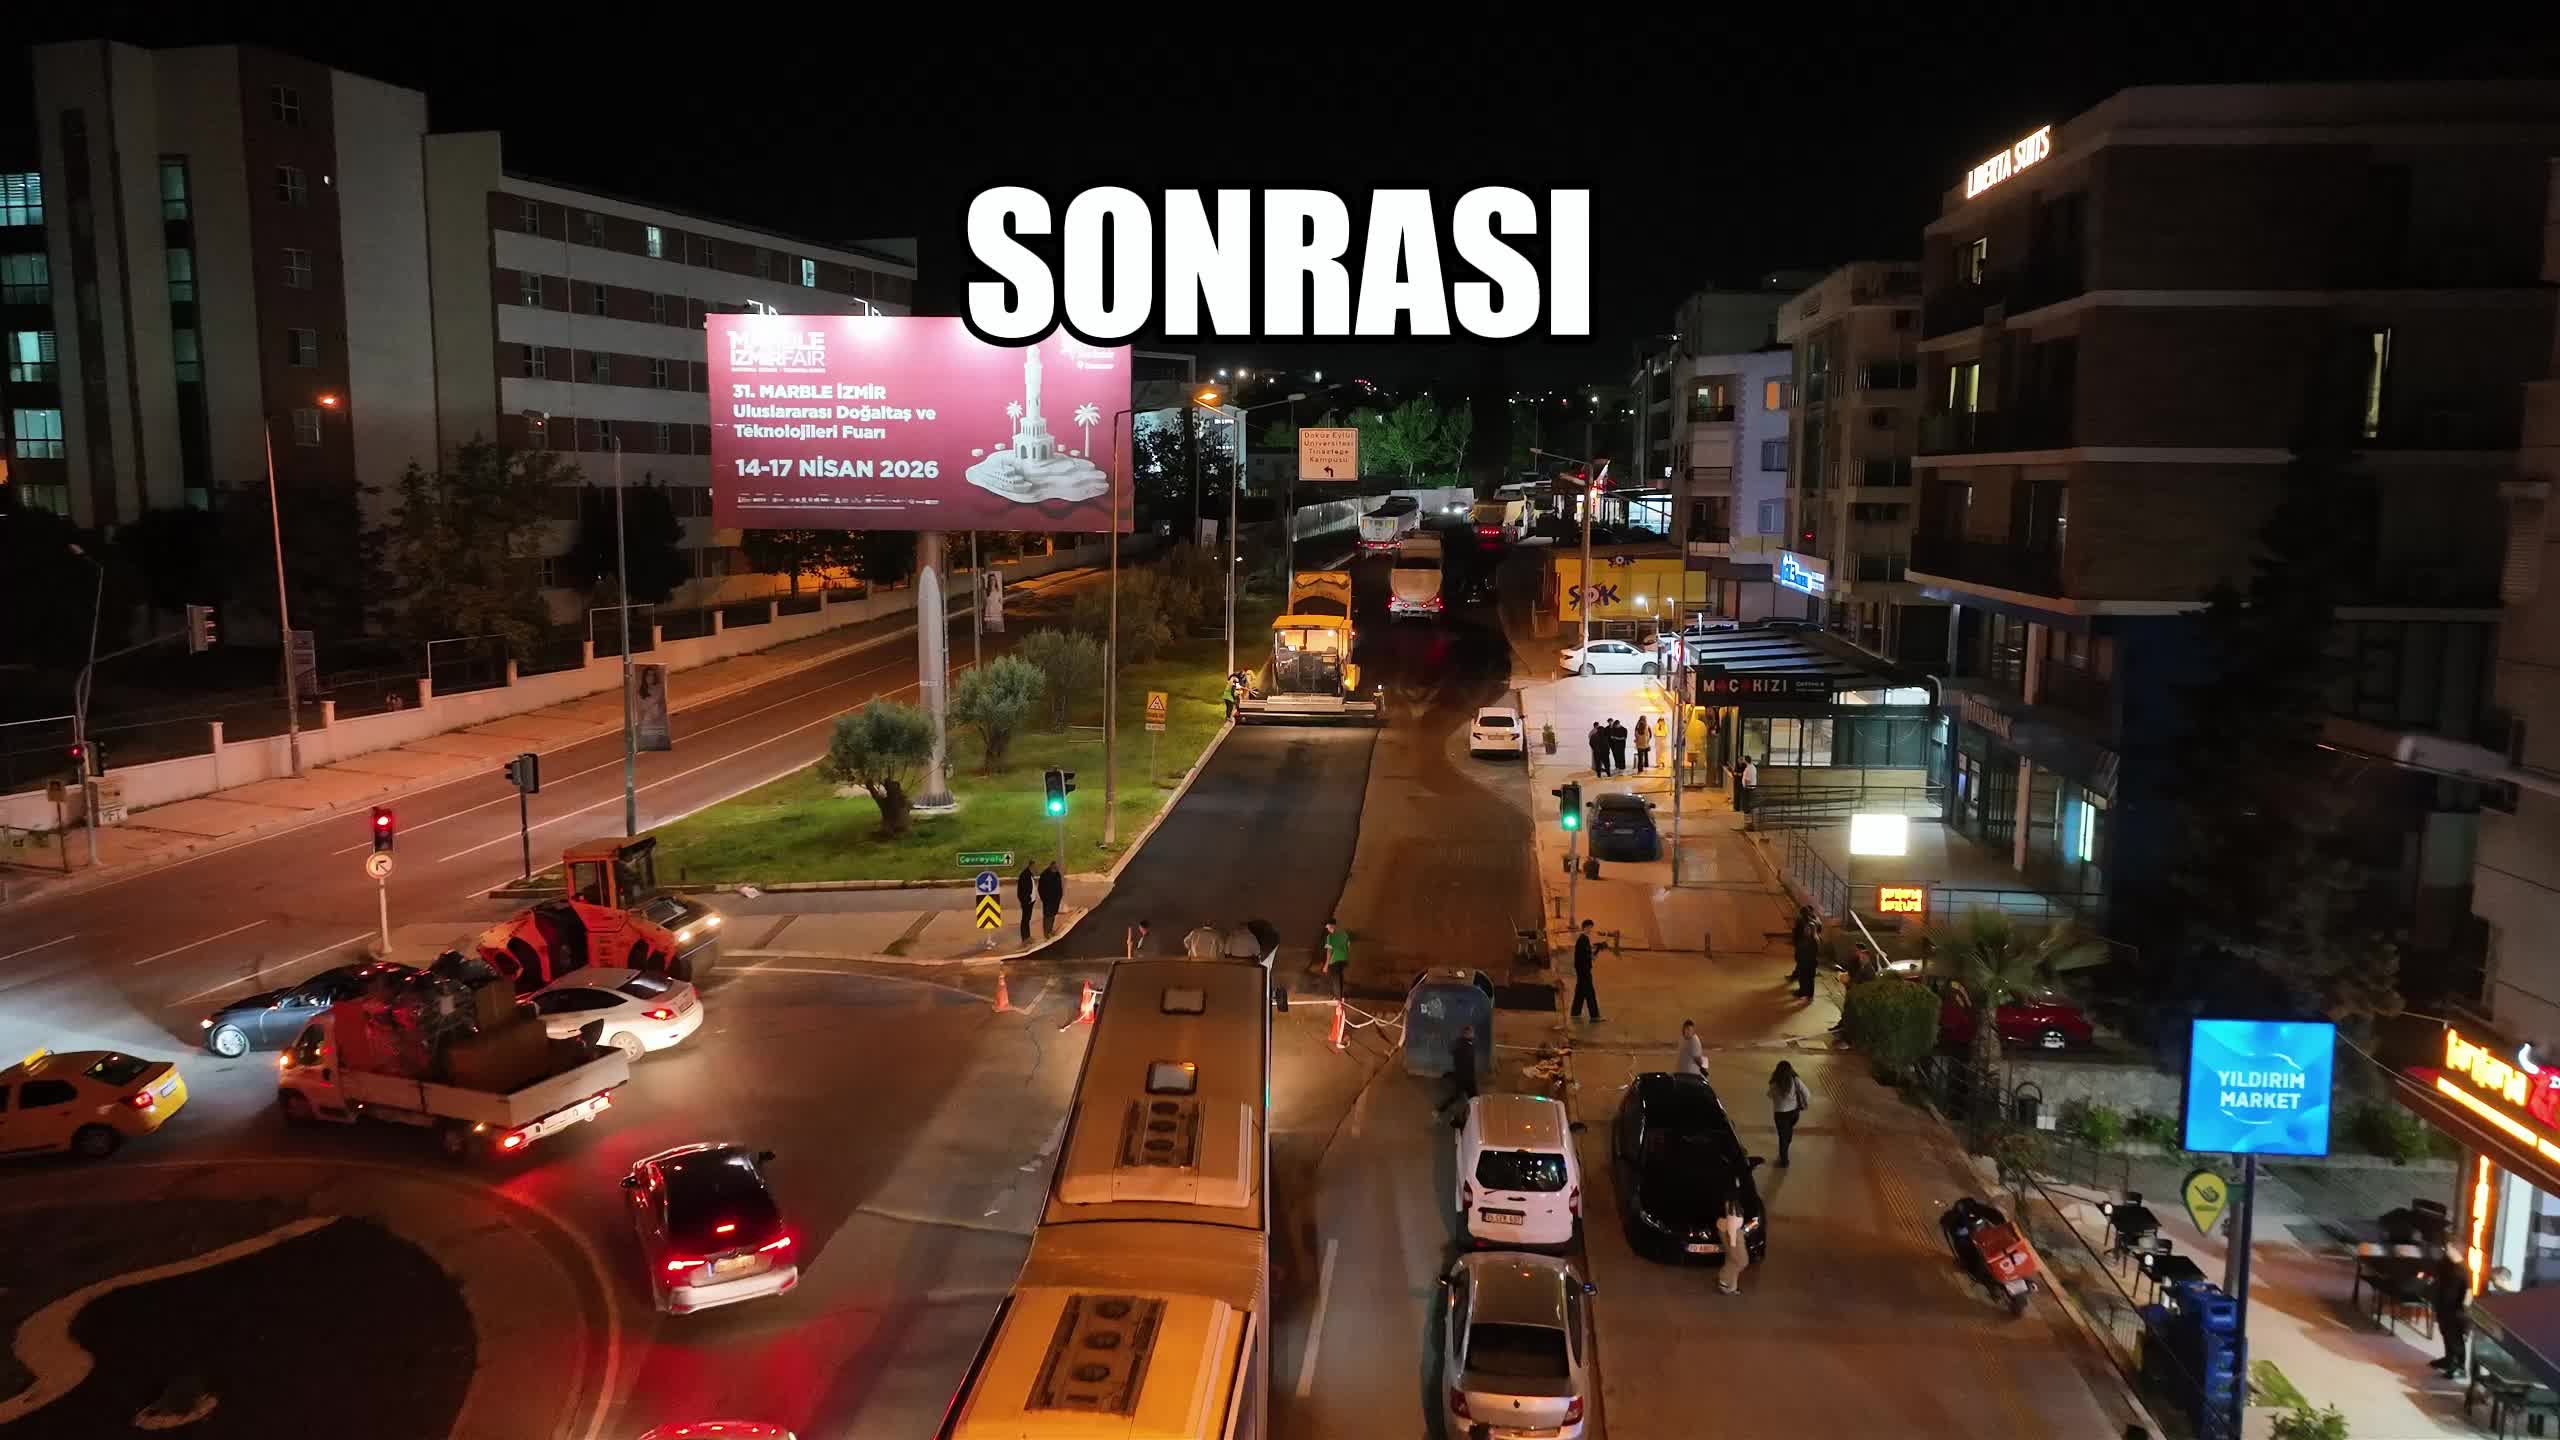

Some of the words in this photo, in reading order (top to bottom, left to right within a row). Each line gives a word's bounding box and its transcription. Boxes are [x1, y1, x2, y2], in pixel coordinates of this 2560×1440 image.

[732, 384, 756, 399] 31.
[759, 384, 833, 399] MARBLE
[837, 382, 887, 400] İZMİR
[733, 404, 833, 419] Uluslararası
[836, 405, 912, 422] Doğaltaş
[916, 408, 937, 420] ve
[733, 423, 838, 441] Teknolojileri
[842, 425, 886, 439] Fuarı
[735, 459, 793, 477] 14-17
[799, 456, 874, 478] NİSAN
[879, 460, 940, 479] 2026
[2217, 1070, 2305, 1089] YILDIRIM
[2220, 1091, 2301, 1109] MARKET
